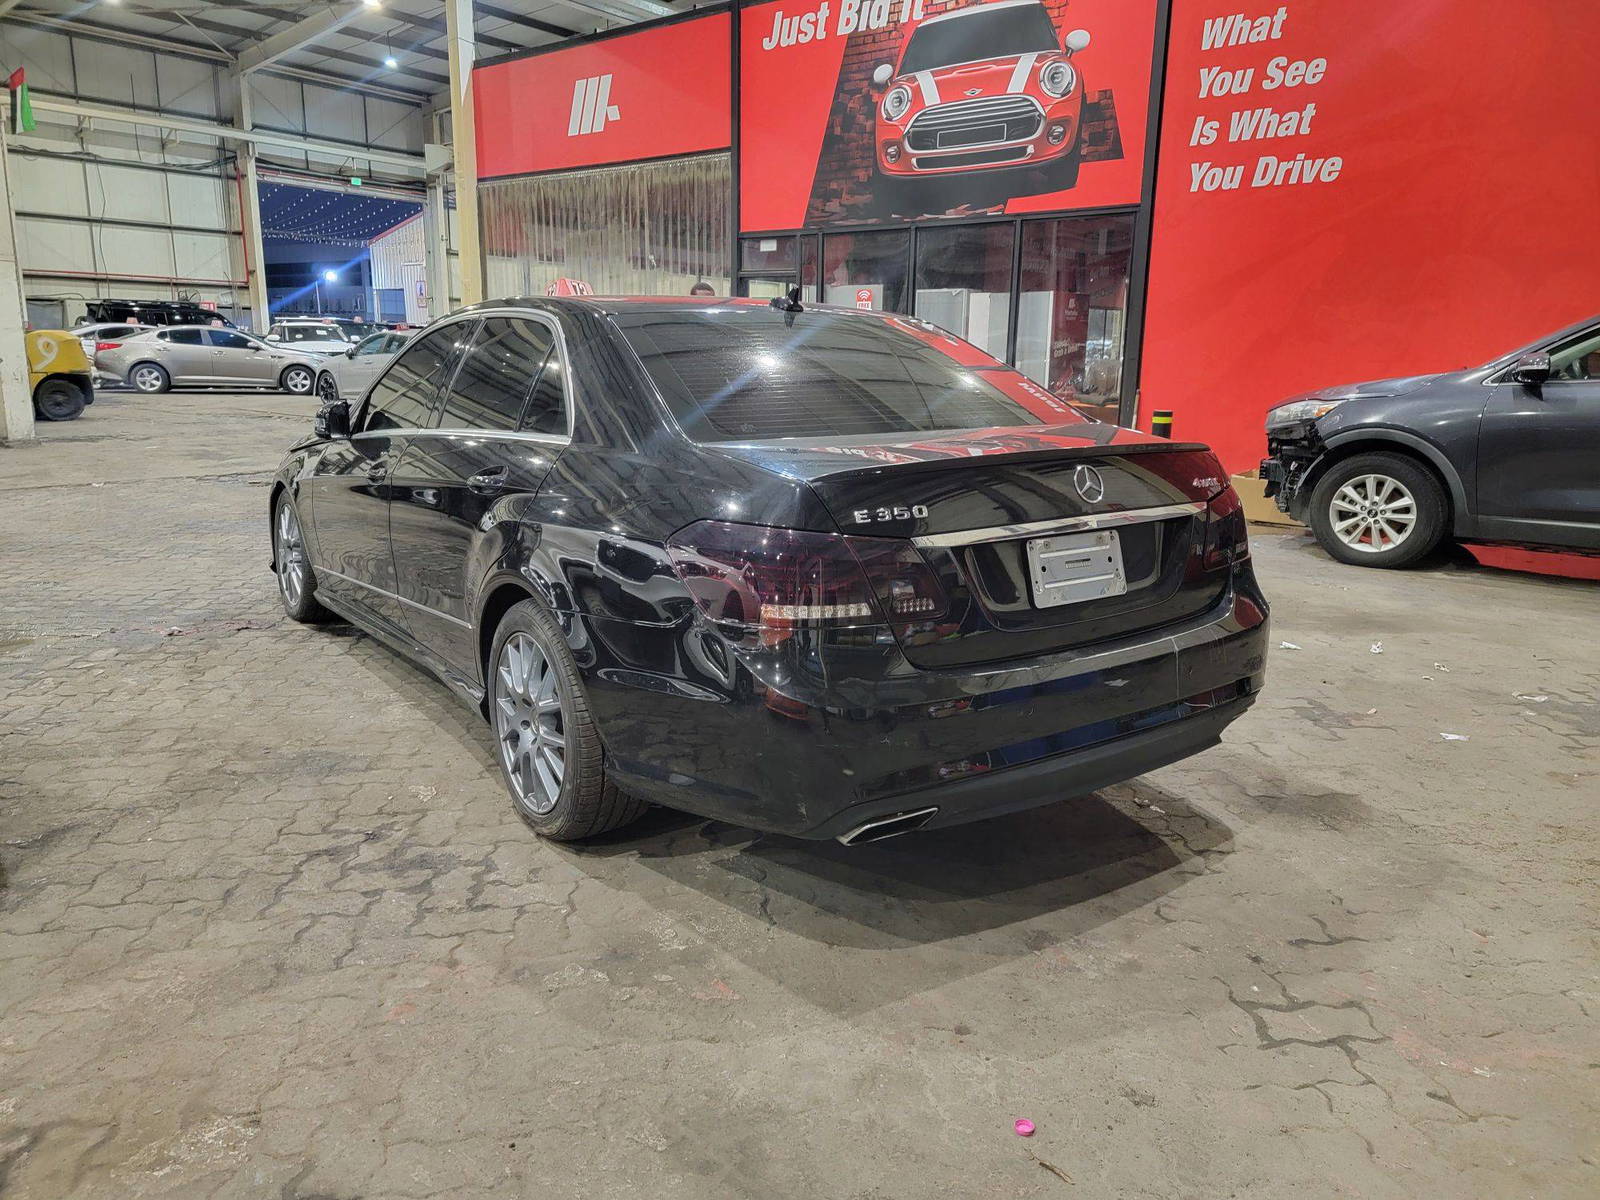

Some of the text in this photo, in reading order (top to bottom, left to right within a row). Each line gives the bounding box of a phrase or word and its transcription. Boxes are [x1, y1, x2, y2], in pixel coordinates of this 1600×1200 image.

[762, 1, 829, 50] Just
[1201, 6, 1288, 50] What
[1198, 56, 1327, 98] You See
[1190, 103, 1316, 146] Is What
[1190, 153, 1343, 192] You Drive
[36, 335, 58, 370] 9
[853, 505, 928, 523] E 350
